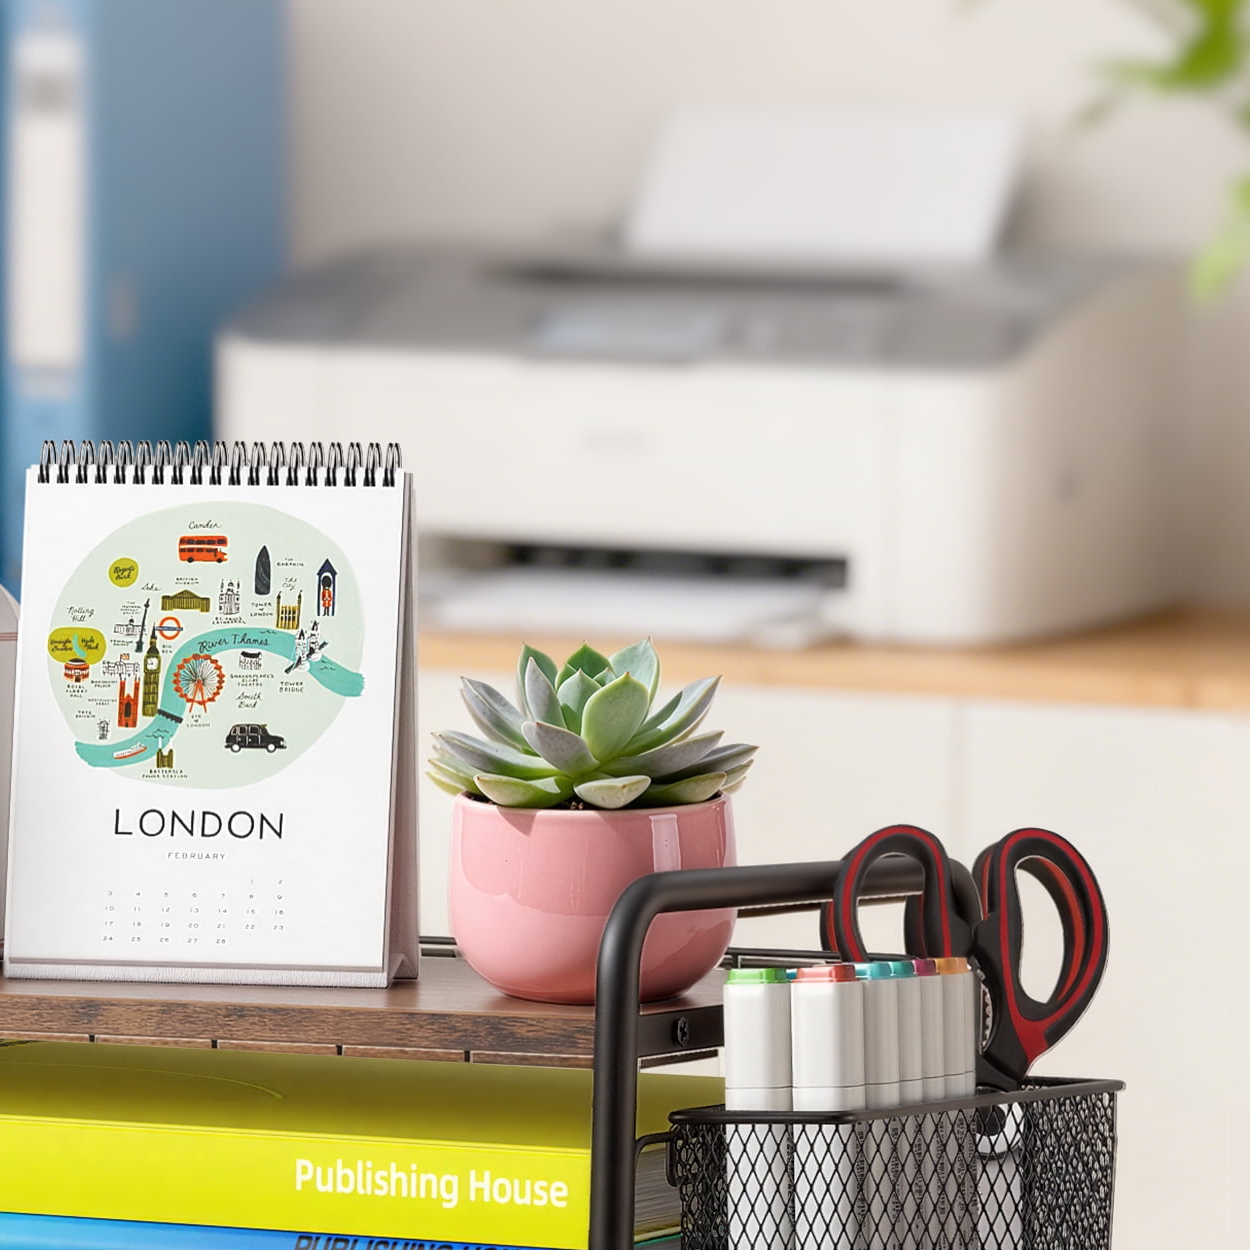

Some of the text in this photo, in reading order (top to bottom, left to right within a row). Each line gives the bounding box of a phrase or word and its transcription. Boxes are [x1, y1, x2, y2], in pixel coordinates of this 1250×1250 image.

[188, 519, 222, 530] Camden
[198, 633, 270, 653] River Thames
[113, 808, 284, 840] LONDON
[167, 852, 227, 861] FEBRUARY
[295, 1158, 568, 1208] Publishing House
